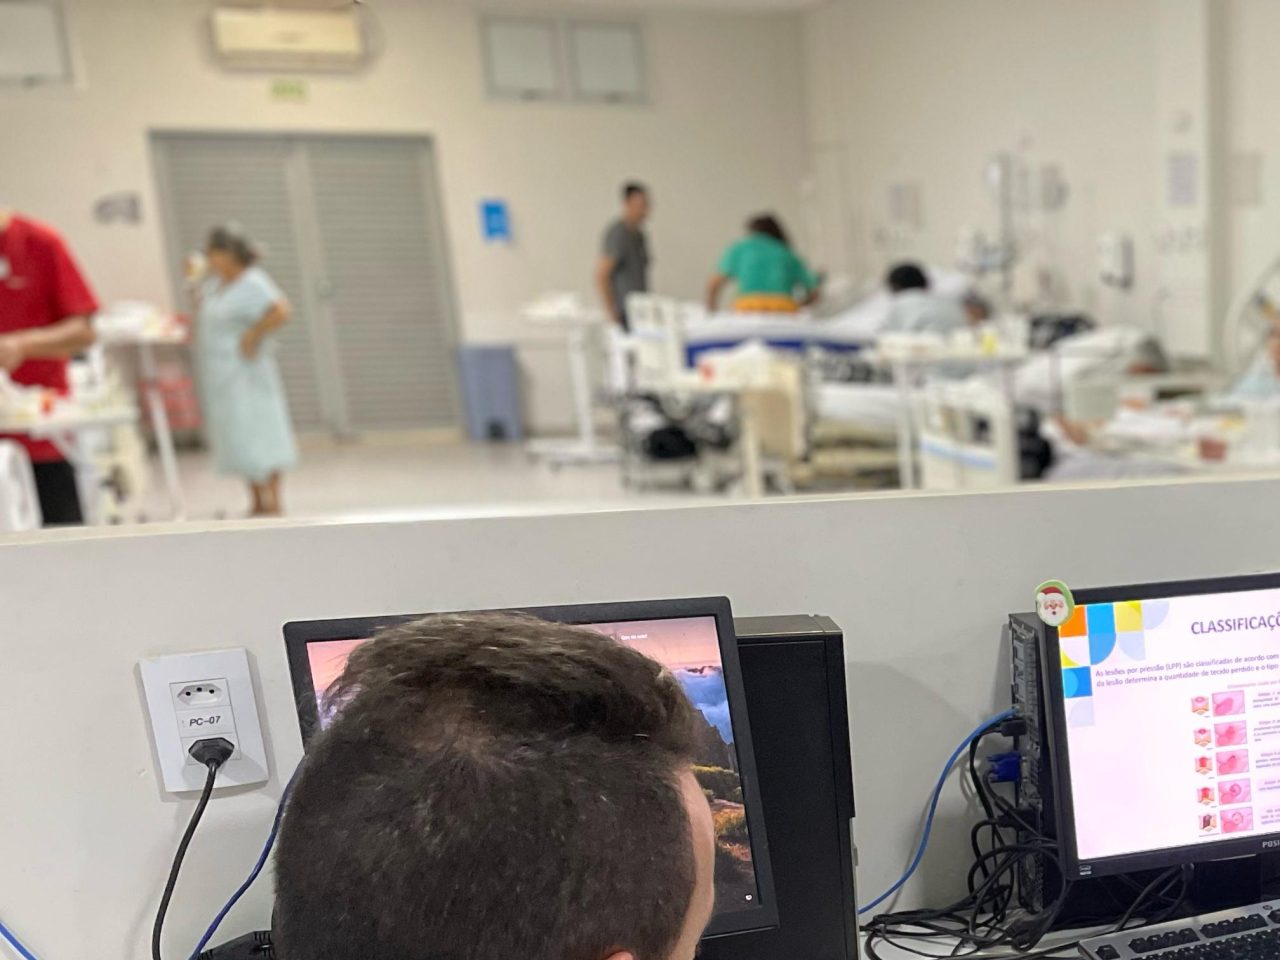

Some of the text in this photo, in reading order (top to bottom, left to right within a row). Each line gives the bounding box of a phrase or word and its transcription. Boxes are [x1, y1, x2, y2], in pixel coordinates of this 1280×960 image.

[1139, 664, 1165, 674] pressão
[1124, 675, 1158, 684] determina
[1164, 671, 1200, 681] quantidade
[189, 715, 221, 727] PC-07
